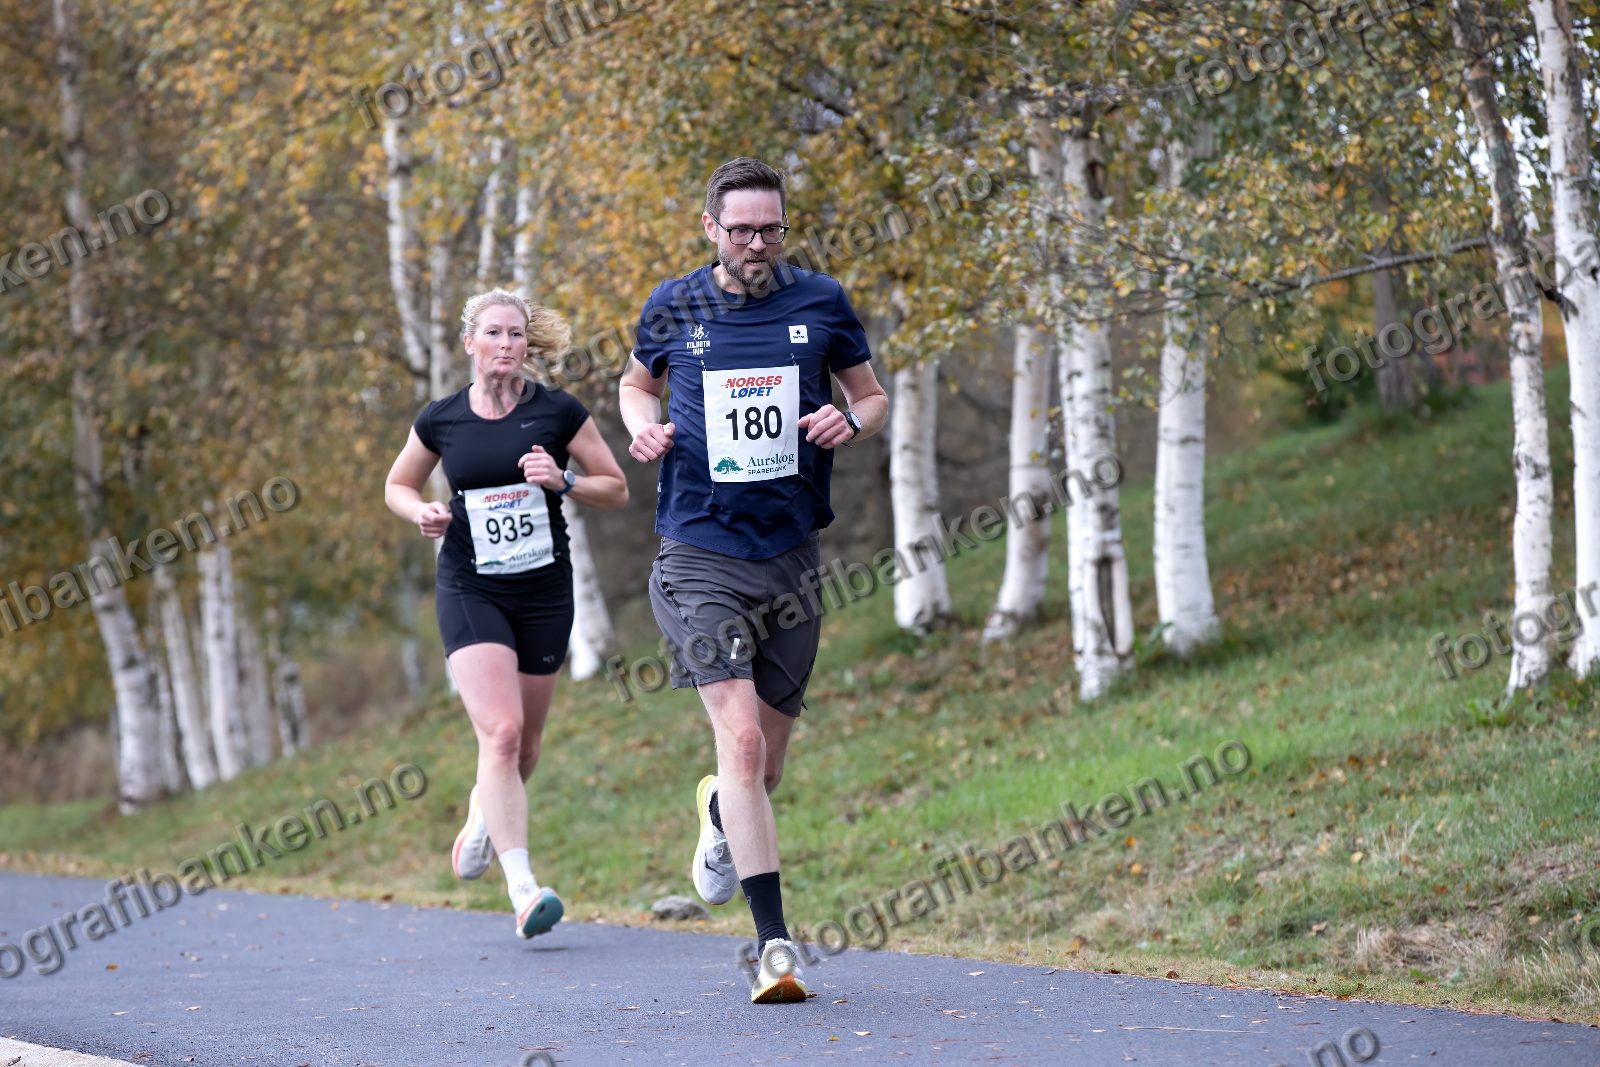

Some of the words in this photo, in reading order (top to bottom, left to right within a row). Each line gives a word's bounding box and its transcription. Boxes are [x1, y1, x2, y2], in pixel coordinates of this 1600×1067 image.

[692, 348, 704, 356] RUN
[726, 375, 783, 388] NORGES
[730, 386, 774, 399] LØPET
[725, 405, 783, 441] 180
[747, 453, 795, 468] Aurskog
[483, 489, 530, 503] NORGES
[485, 513, 534, 545] 935
